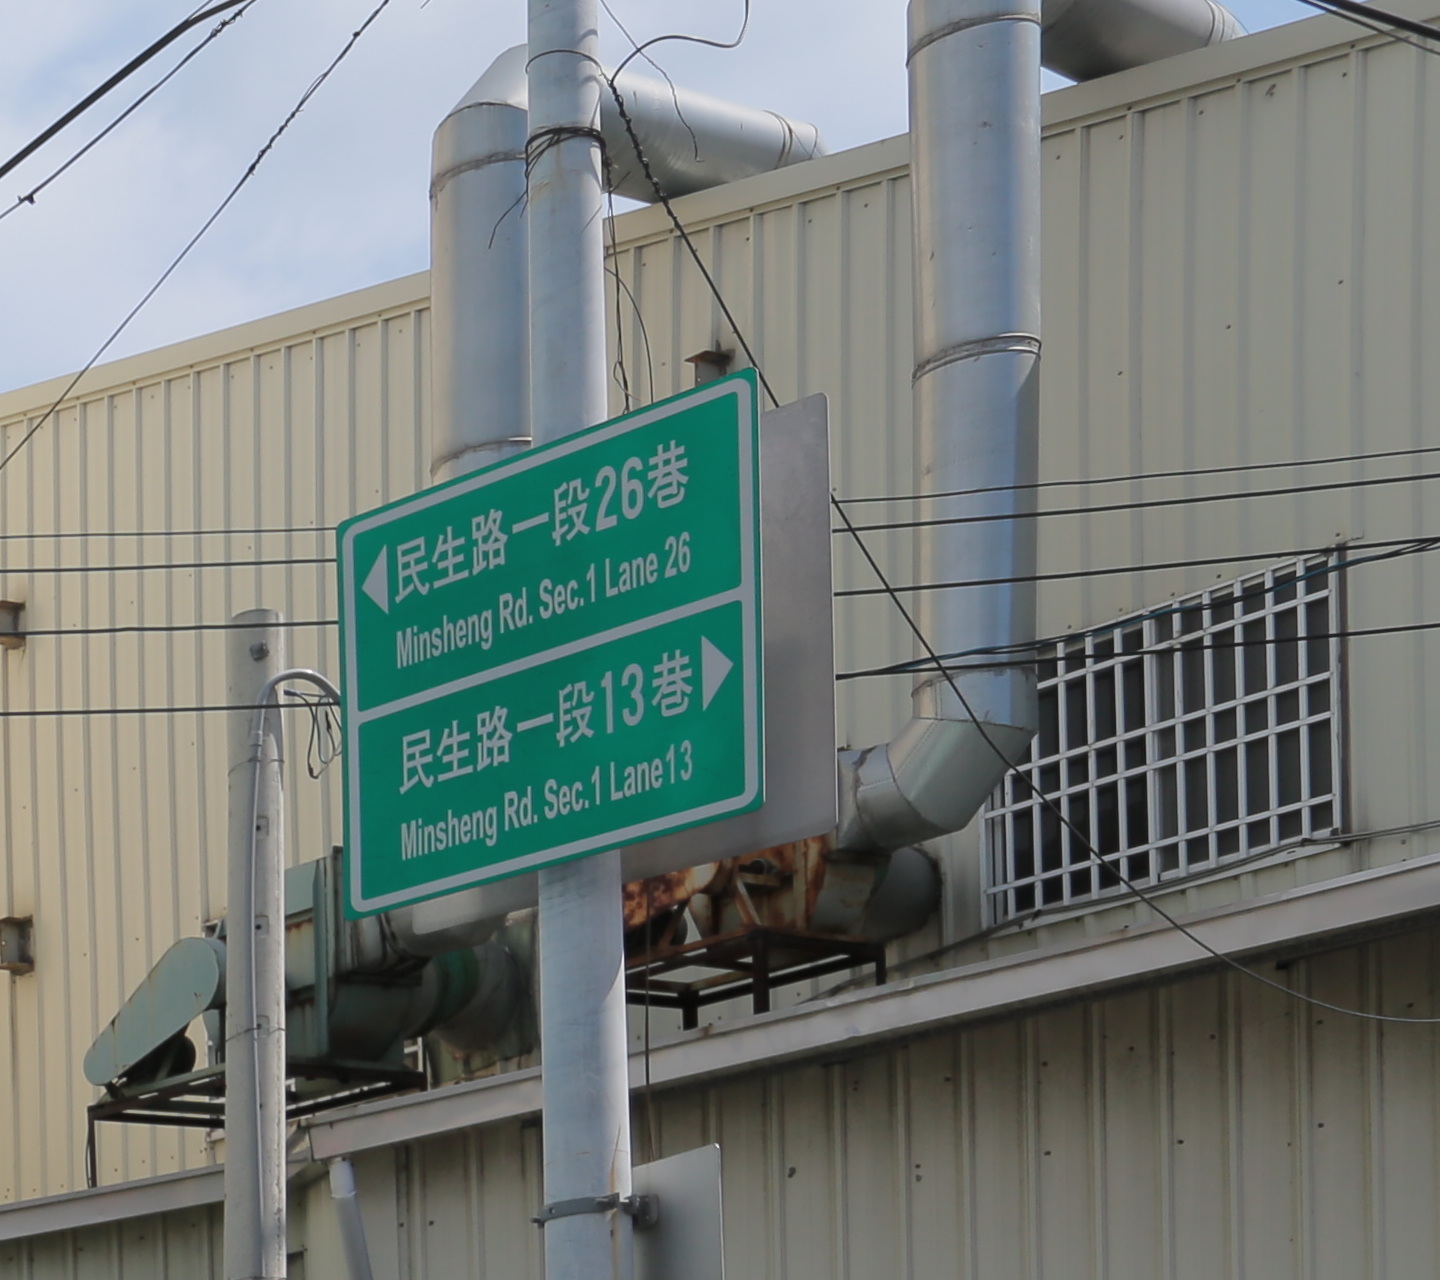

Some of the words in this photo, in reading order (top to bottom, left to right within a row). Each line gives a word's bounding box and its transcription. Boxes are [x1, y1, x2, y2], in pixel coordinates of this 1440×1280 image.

[394, 440, 690, 604] 民生路一段26巷
[395, 600, 494, 668] Minsheng
[498, 588, 534, 635] Rd.
[604, 552, 659, 598] Lane
[664, 531, 691, 579] 26
[399, 649, 693, 795] 民生路一段13巷
[400, 804, 499, 861] Minsheng
[503, 789, 539, 830] Rd.
